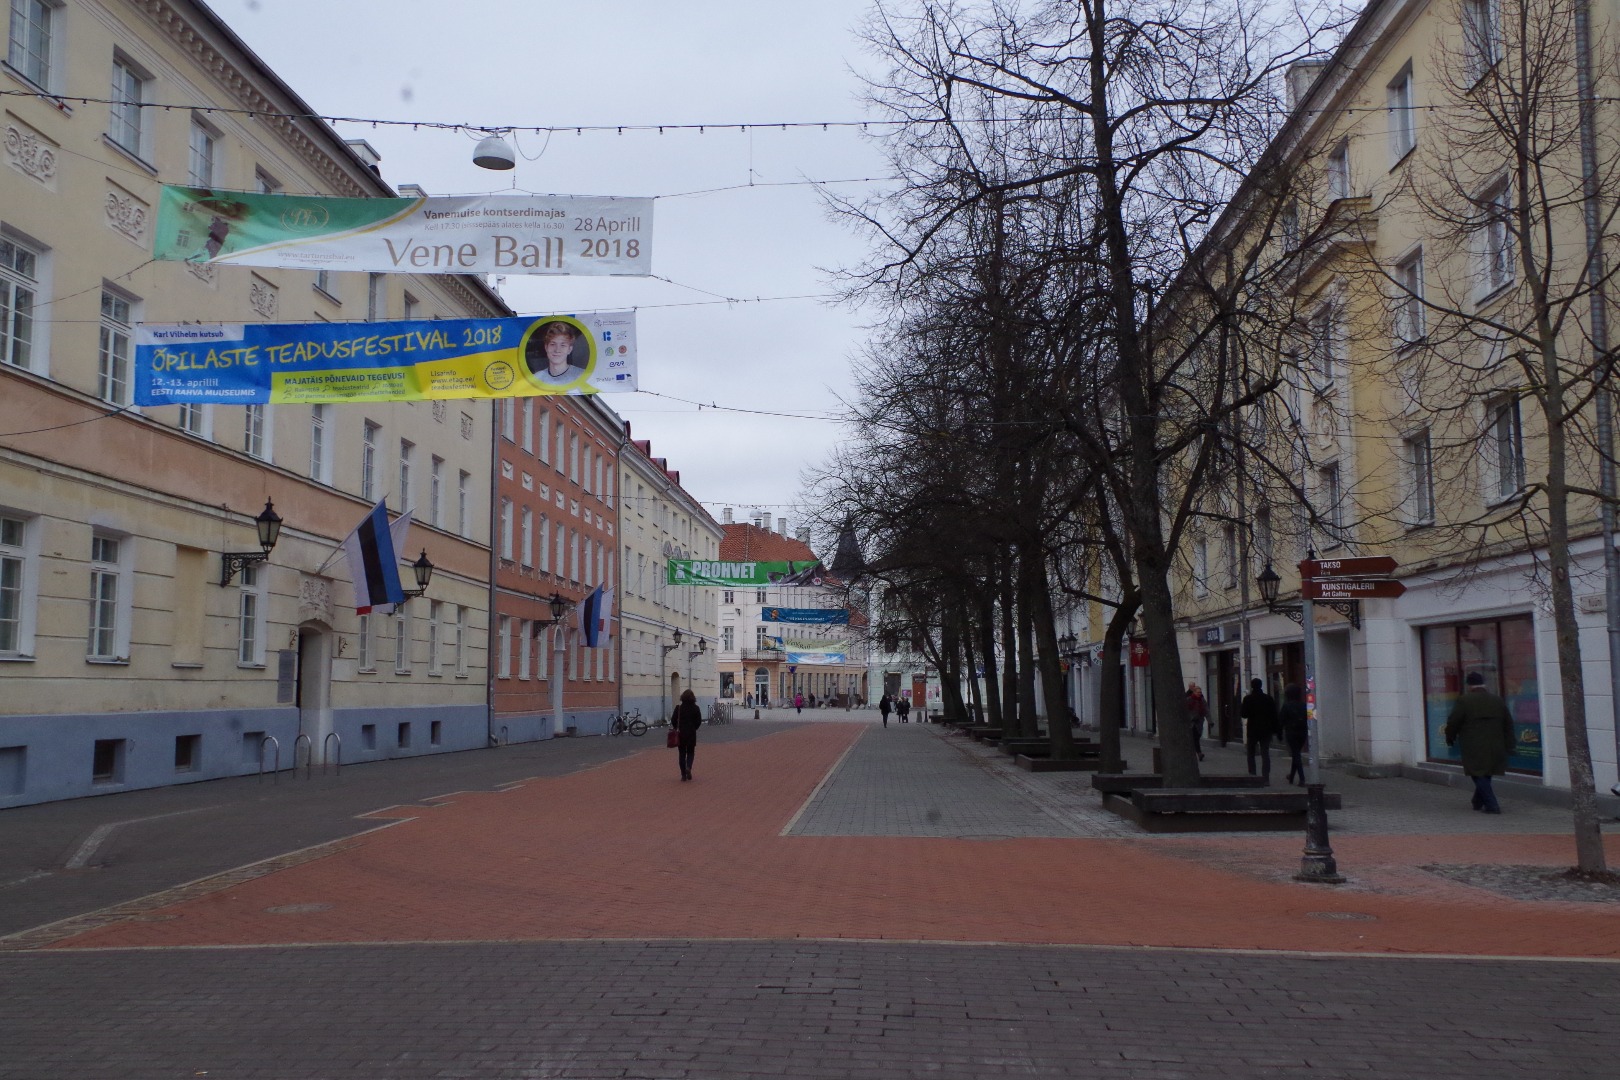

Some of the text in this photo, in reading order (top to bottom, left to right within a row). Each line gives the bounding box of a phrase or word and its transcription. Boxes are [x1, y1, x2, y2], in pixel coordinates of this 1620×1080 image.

[424, 206, 566, 220] Vanemuise kontserdimajas
[574, 216, 641, 236] 28 Aprill
[382, 235, 564, 269] Vene Ball
[580, 238, 640, 258] 2018
[152, 325, 503, 371] ÕPILASTE TEADUSFESTIVAL 2018
[186, 379, 219, 387] aprillil
[284, 372, 405, 385] MAJATÄIS PÕNEVAID TEGEVUSI
[151, 388, 173, 396] EESTI
[205, 389, 256, 397] MUUSEUMIS
[692, 561, 757, 579] PROHVET
[1320, 561, 1341, 569] TAKSO
[1321, 582, 1375, 591] KUNSTIGALERII
